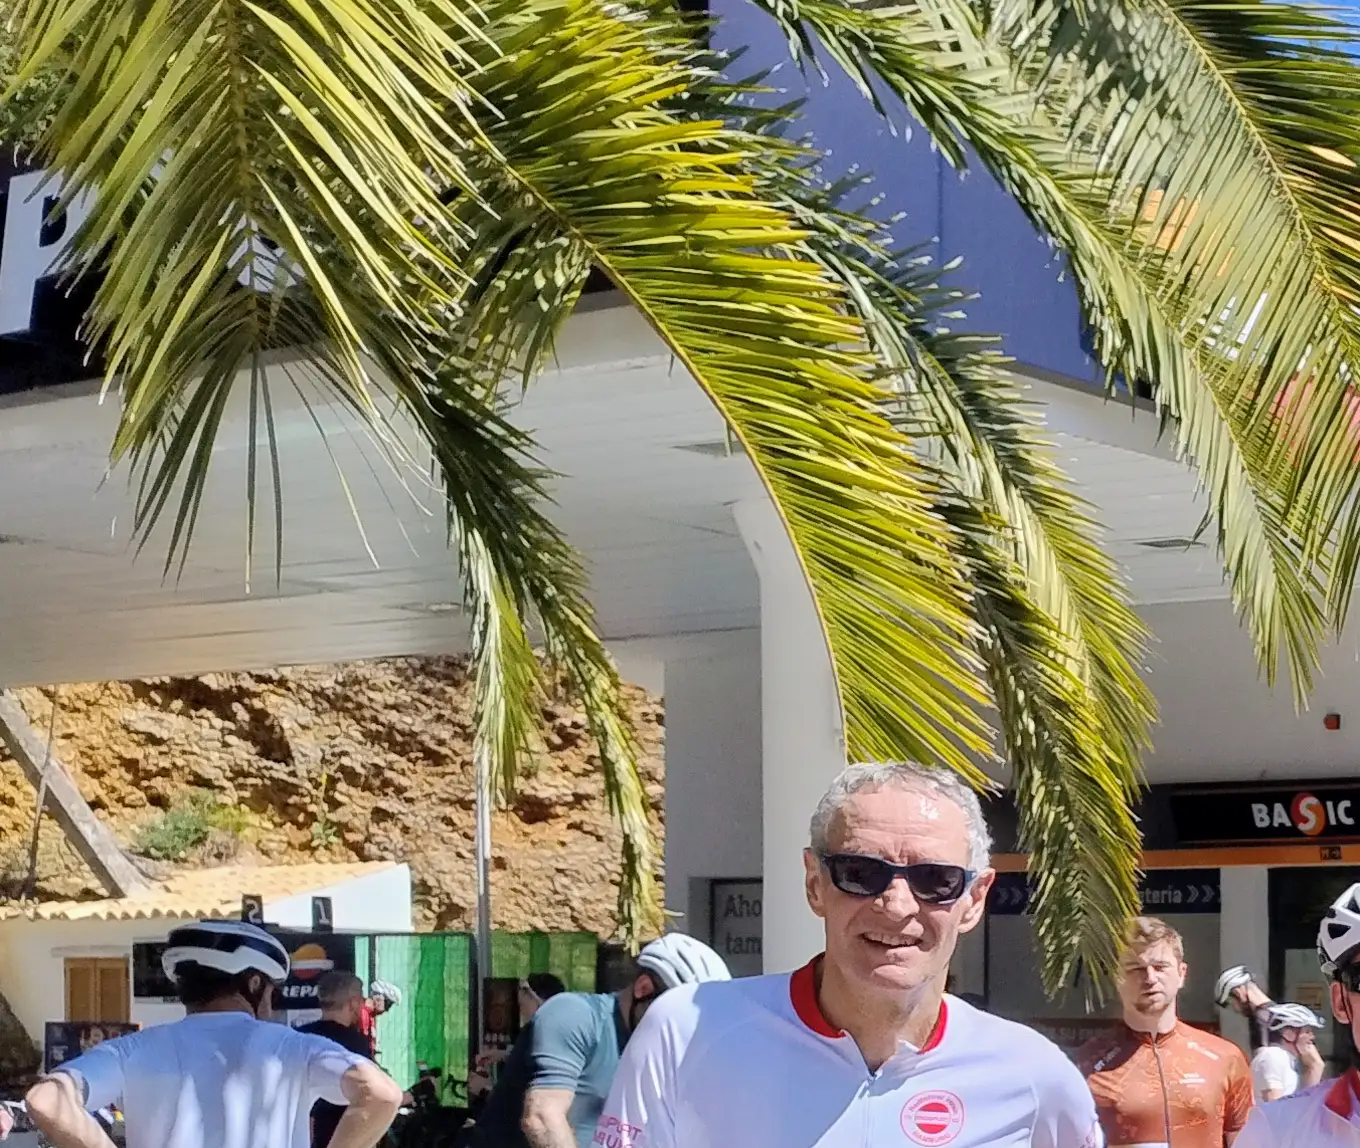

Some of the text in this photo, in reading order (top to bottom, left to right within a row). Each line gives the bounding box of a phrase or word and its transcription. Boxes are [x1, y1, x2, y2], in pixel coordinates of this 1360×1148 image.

[1251, 796, 1355, 832] BASIC
[246, 901, 263, 924] 2
[314, 900, 331, 924] 1
